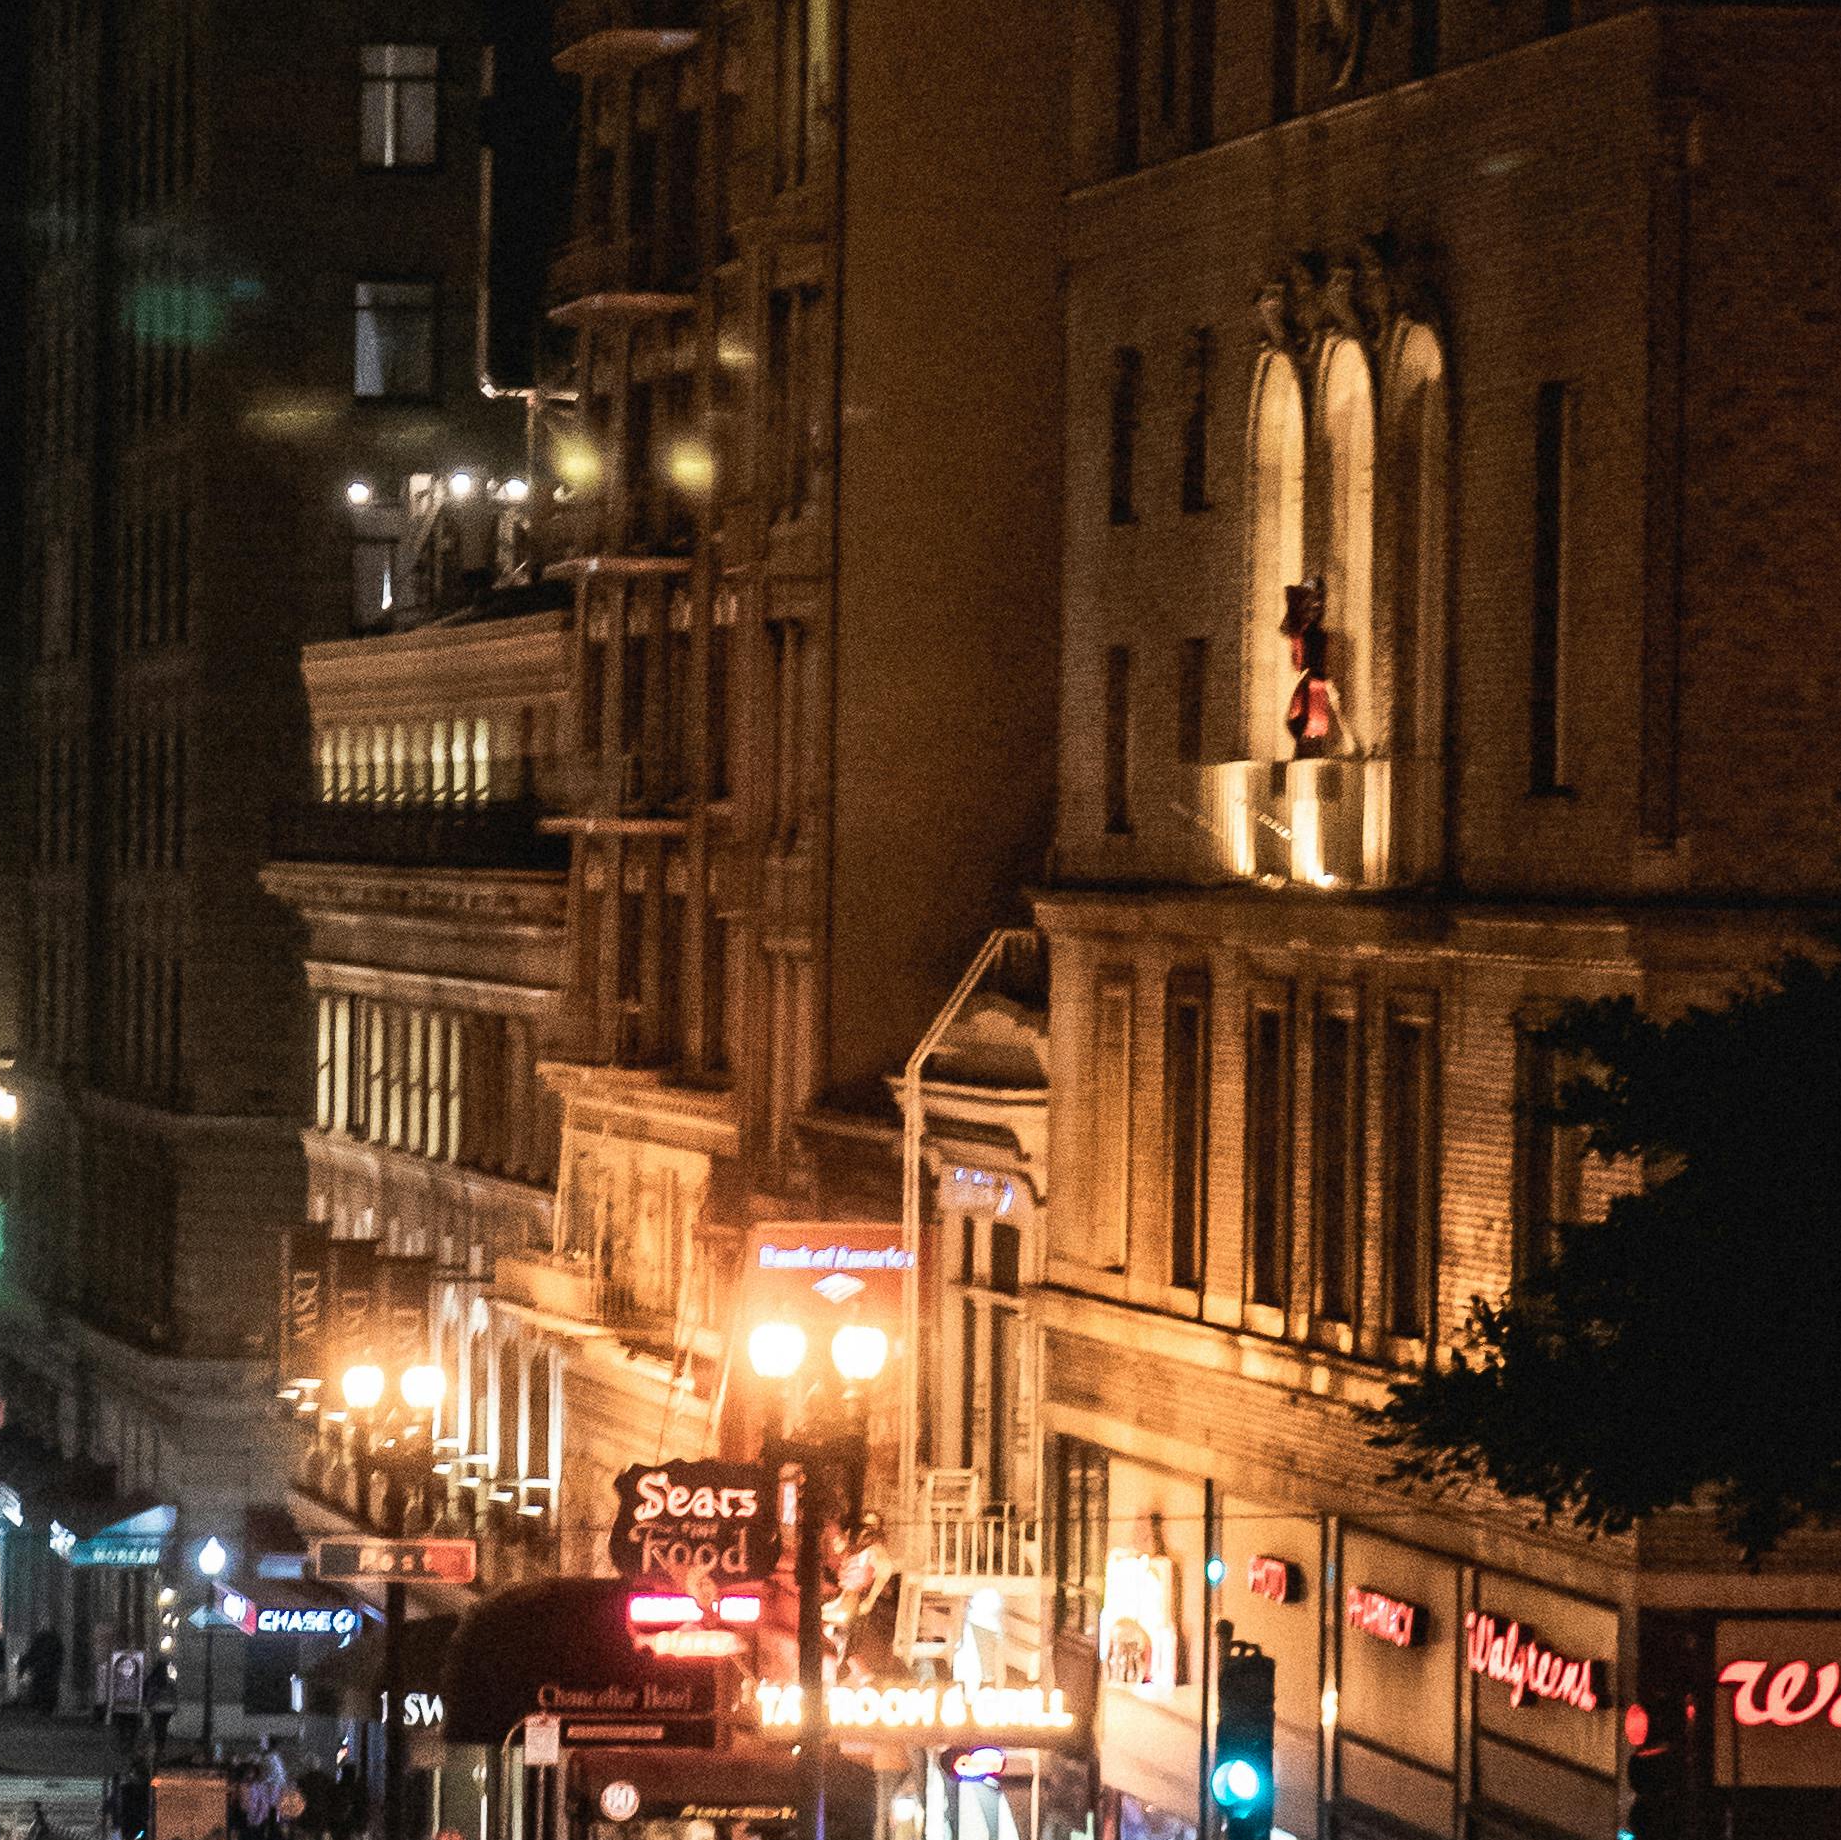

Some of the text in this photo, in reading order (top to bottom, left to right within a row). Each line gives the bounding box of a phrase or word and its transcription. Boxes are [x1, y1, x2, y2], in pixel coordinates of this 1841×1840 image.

[633, 1470, 758, 1521] Sears
[257, 1609, 332, 1633] CHASE
[1464, 1610, 1597, 1712] Walgreens
[827, 1687, 937, 1728] ROOM
[940, 1687, 968, 1728] &
[970, 1687, 1075, 1729] GRILL
[1718, 1660, 1841, 1727] W
